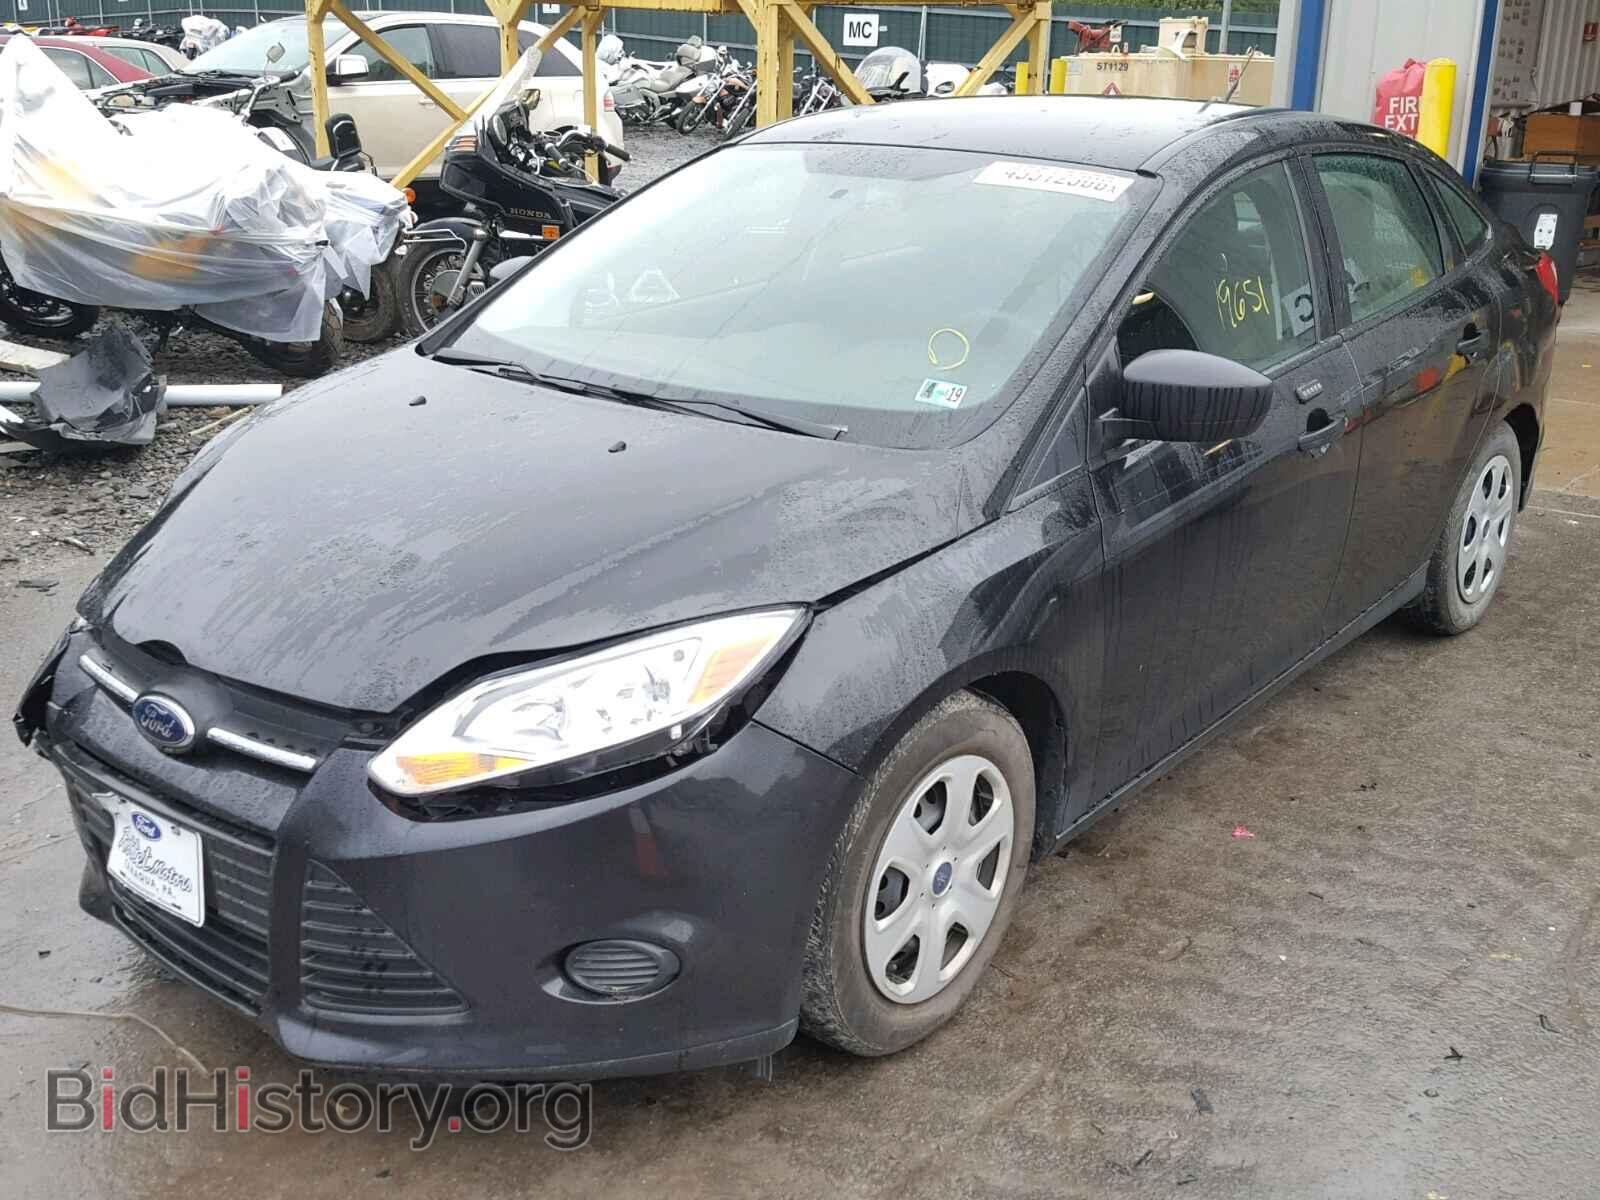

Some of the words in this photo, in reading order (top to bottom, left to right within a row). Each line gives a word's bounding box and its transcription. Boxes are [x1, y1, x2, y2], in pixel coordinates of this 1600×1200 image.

[848, 21, 873, 39] MC
[1389, 95, 1418, 114] FIR
[1384, 113, 1419, 131] EXT
[510, 207, 552, 219] HONDA
[141, 703, 175, 738] Ford
[135, 814, 159, 837] Ford
